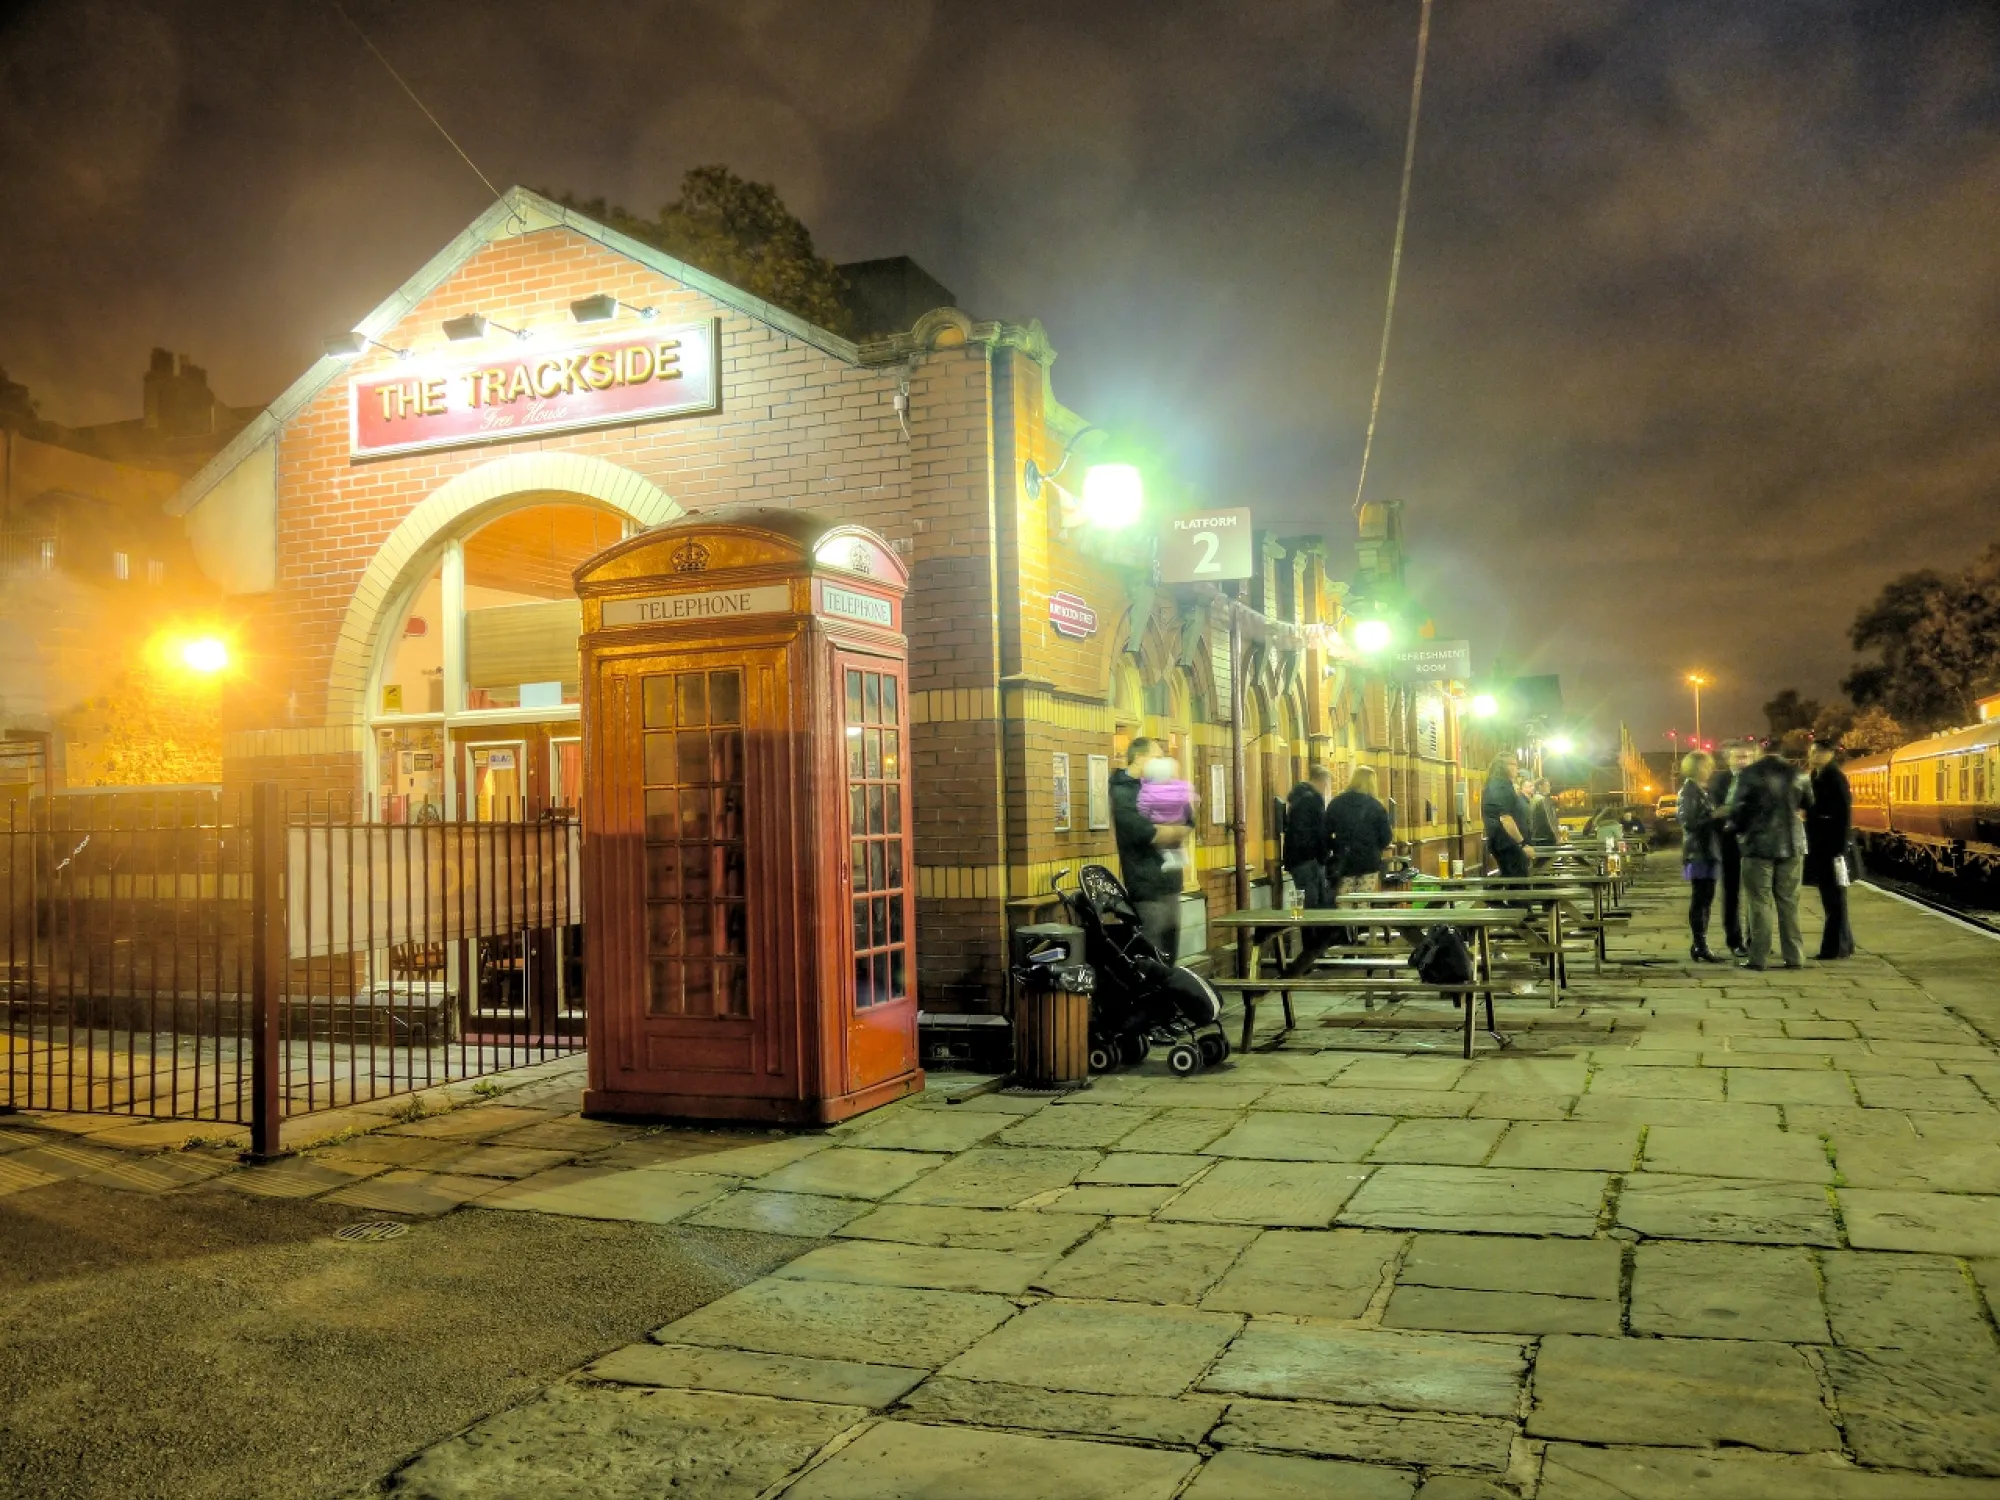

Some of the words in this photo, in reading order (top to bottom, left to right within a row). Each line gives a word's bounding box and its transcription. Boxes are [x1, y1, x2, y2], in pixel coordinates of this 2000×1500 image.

[375, 378, 448, 423] THE
[460, 339, 683, 410] TRACKSIDE
[480, 406, 515, 430] Free
[521, 401, 568, 425] House
[1174, 515, 1237, 530] PLATFORM
[1192, 531, 1221, 574] 2
[636, 593, 752, 621] TELEPHONE
[826, 591, 889, 622] TELEPHONE
[1396, 648, 1466, 661] REFRESHMENT
[1415, 663, 1447, 674] ROOM
